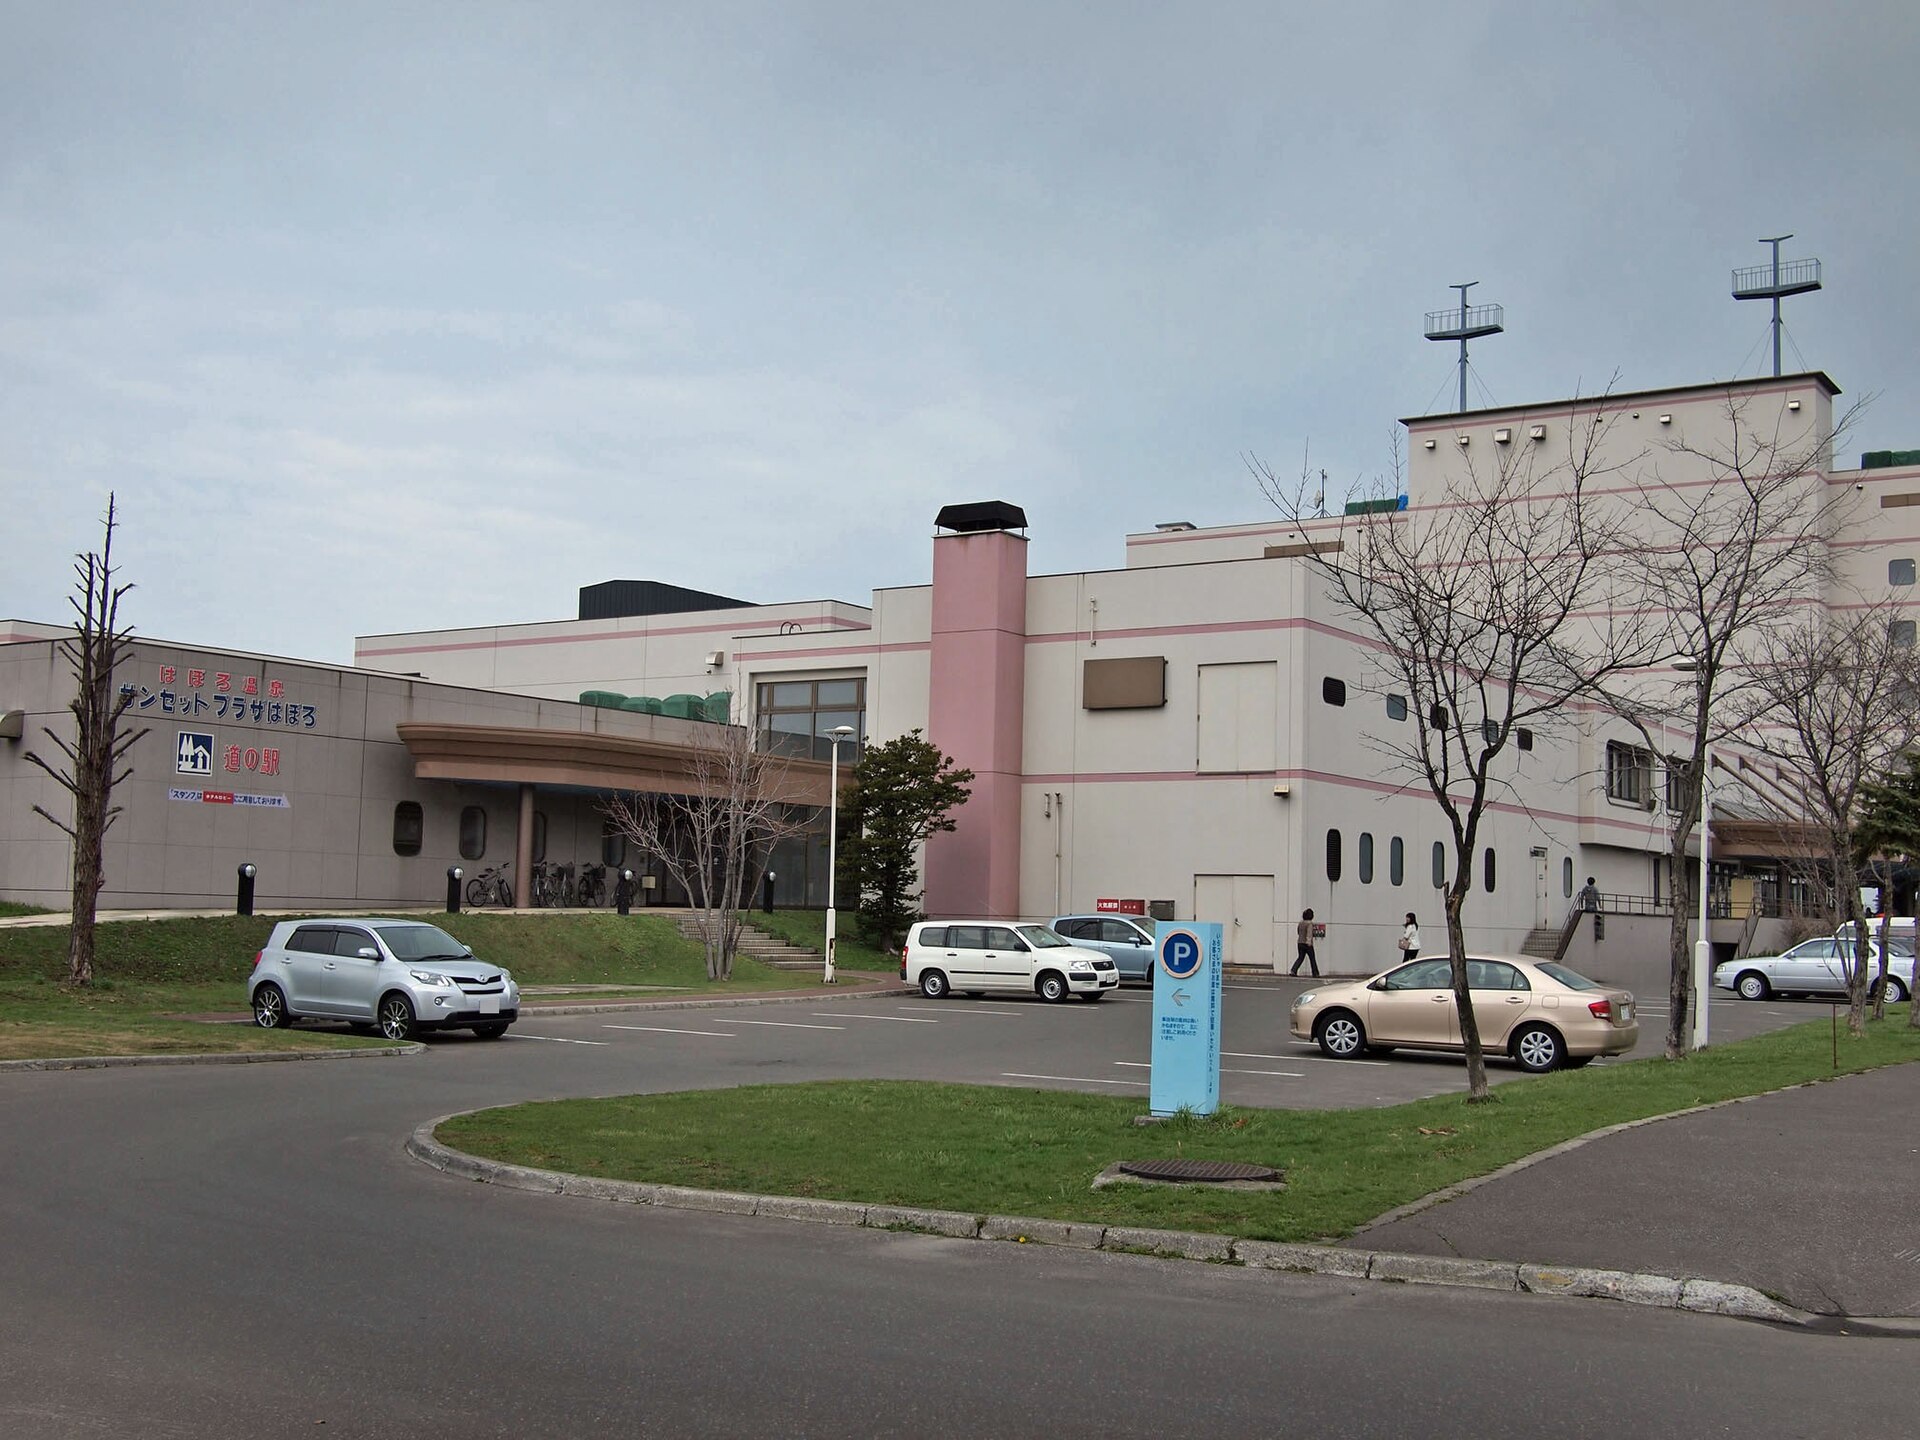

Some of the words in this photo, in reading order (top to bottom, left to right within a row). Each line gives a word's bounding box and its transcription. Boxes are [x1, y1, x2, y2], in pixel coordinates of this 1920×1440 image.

[223, 744, 281, 776] 道の駅
[1173, 942, 1192, 967] P
